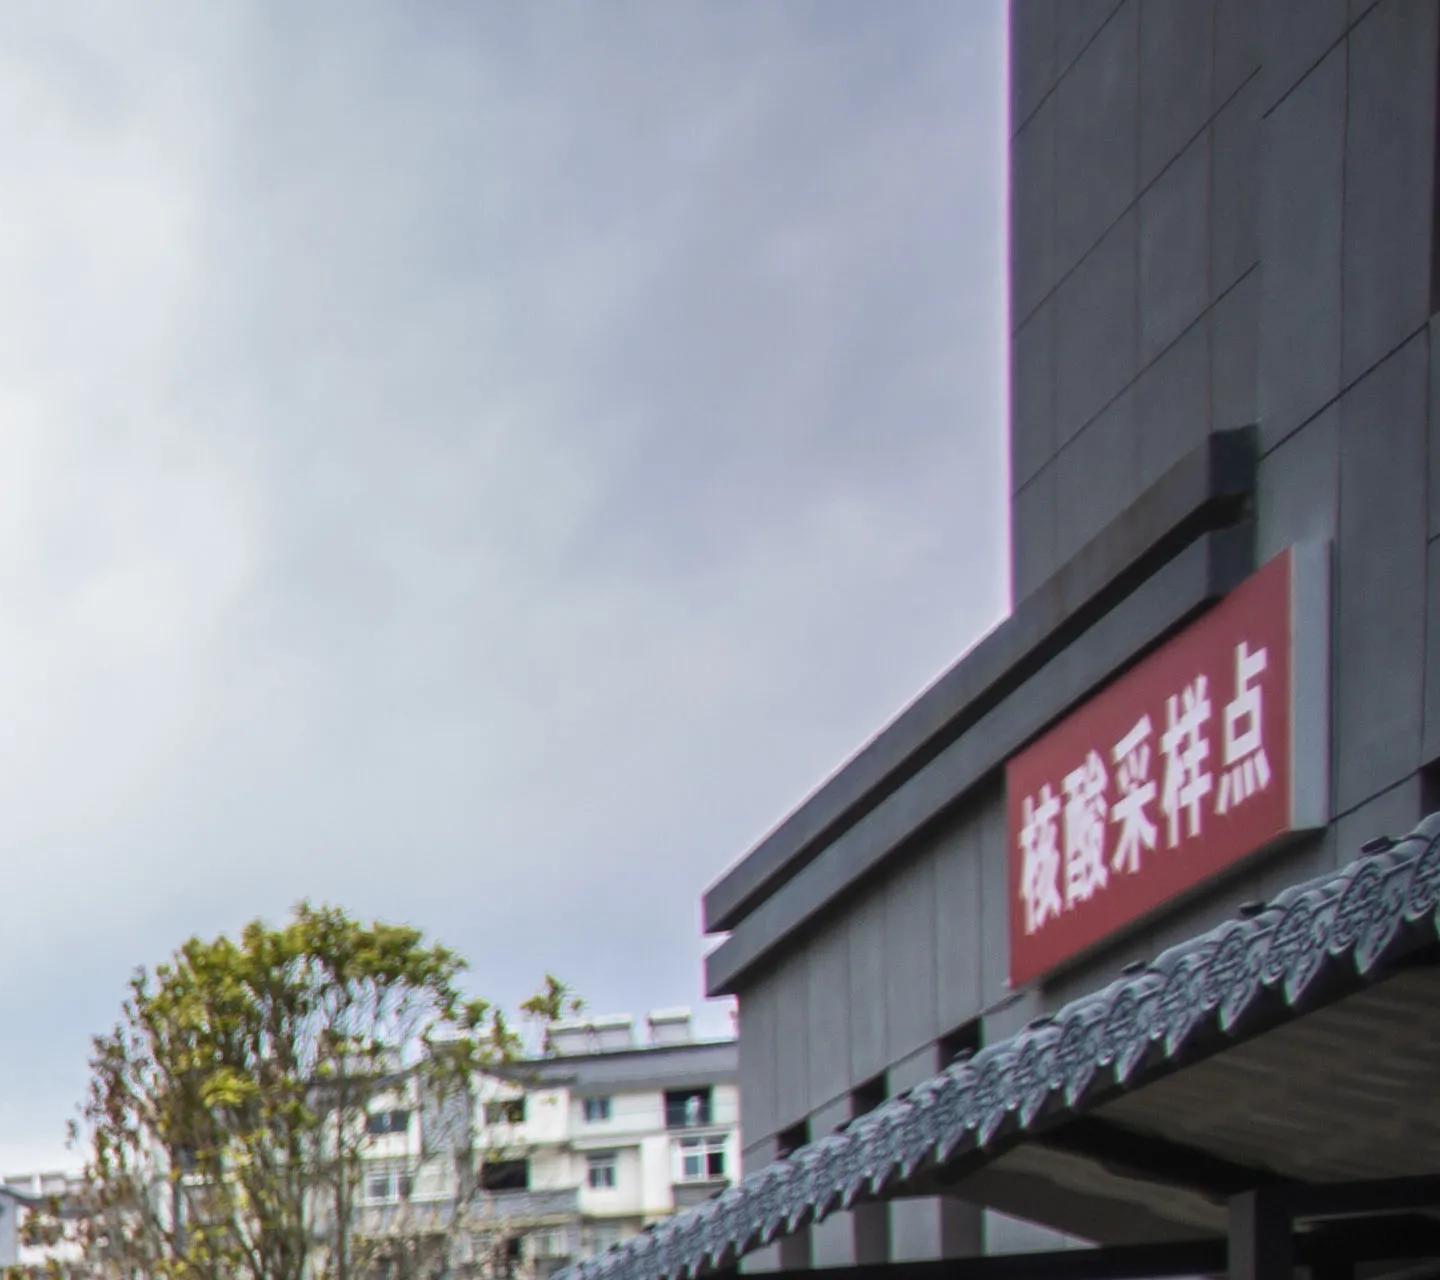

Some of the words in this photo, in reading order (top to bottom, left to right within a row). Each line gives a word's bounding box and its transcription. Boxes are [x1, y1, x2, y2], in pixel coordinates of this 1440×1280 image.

[1019, 641, 1271, 935] 核酸采样点
